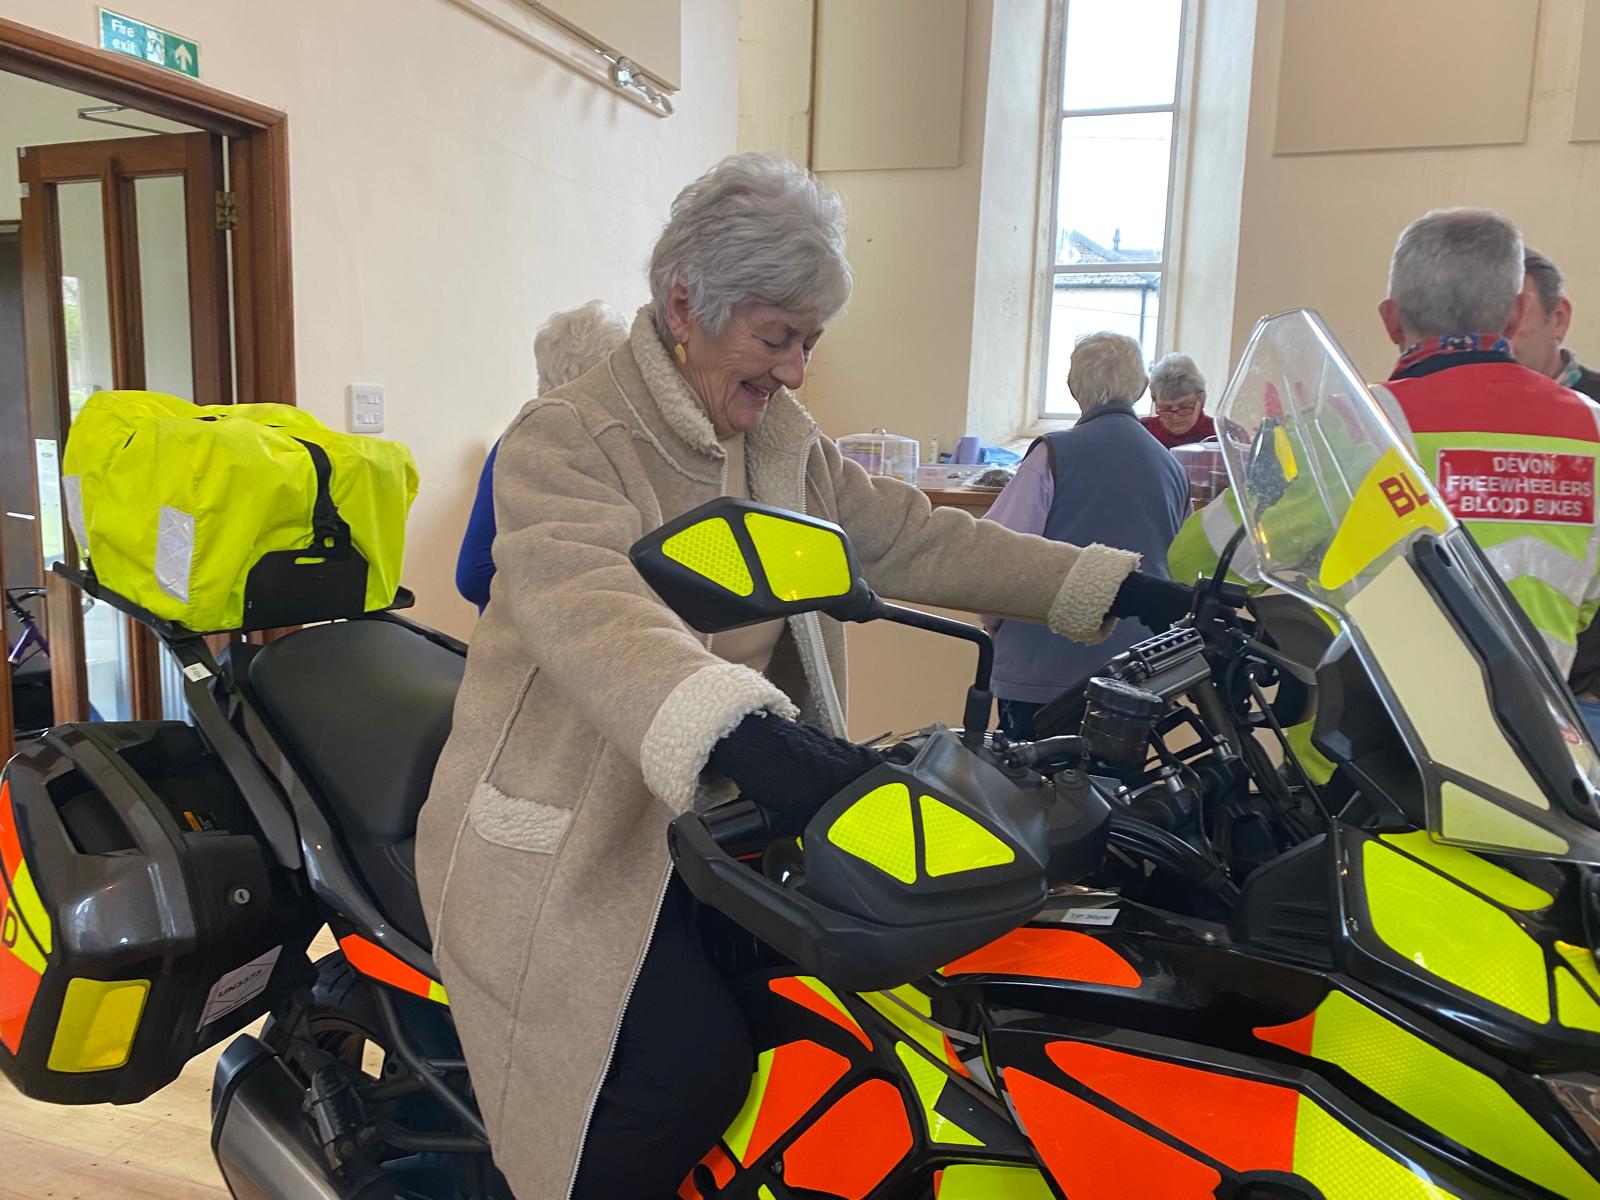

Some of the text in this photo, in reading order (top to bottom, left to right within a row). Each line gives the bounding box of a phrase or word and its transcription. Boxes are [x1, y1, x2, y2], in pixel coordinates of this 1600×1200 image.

[112, 39, 136, 56] exit
[1493, 456, 1557, 475] DEVON
[1446, 475, 1593, 498] FREEWHEELERS
[1460, 495, 1583, 517] BLOOD BIKES
